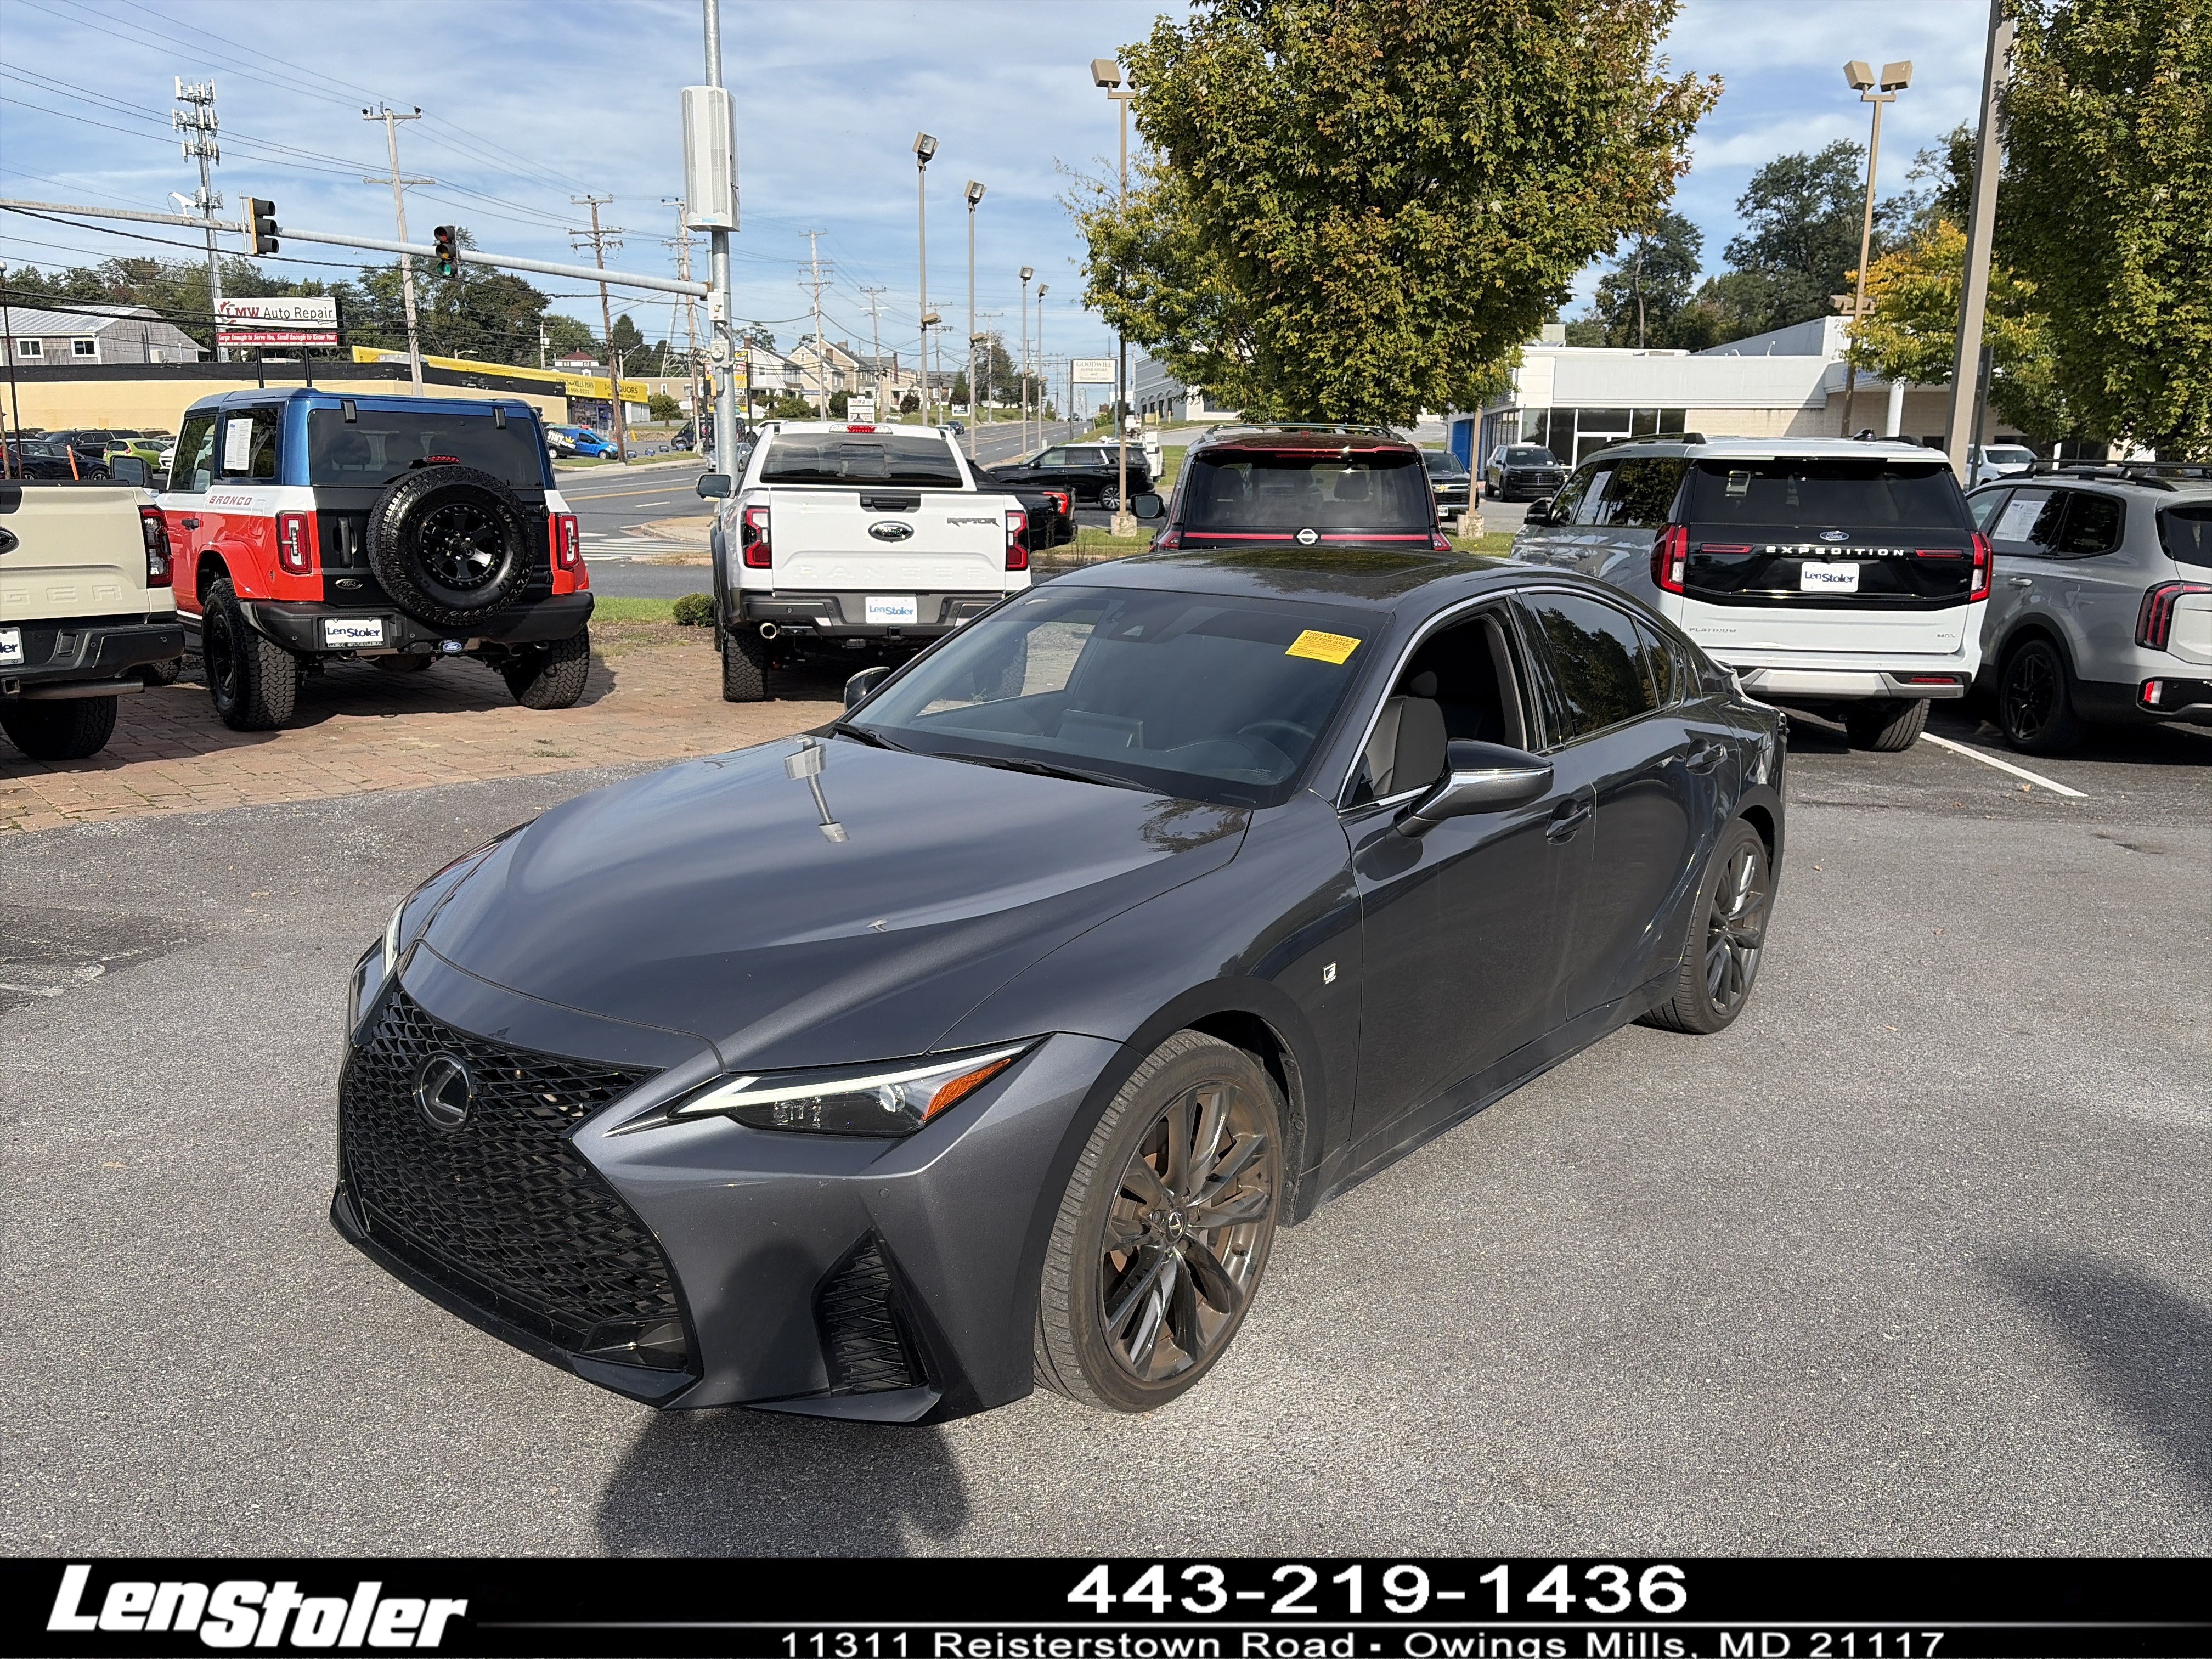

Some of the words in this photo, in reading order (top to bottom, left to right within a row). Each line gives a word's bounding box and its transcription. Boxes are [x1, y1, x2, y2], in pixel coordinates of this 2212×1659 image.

[226, 307, 259, 318] LMW
[264, 307, 290, 319] Auto
[294, 307, 332, 320] Repair
[290, 334, 306, 342] Enough
[209, 495, 253, 505] BRONCO
[947, 517, 1000, 527] RAPTOR
[1765, 546, 1904, 556] EXPEDITION
[1324, 634, 1357, 644] VEHICLE
